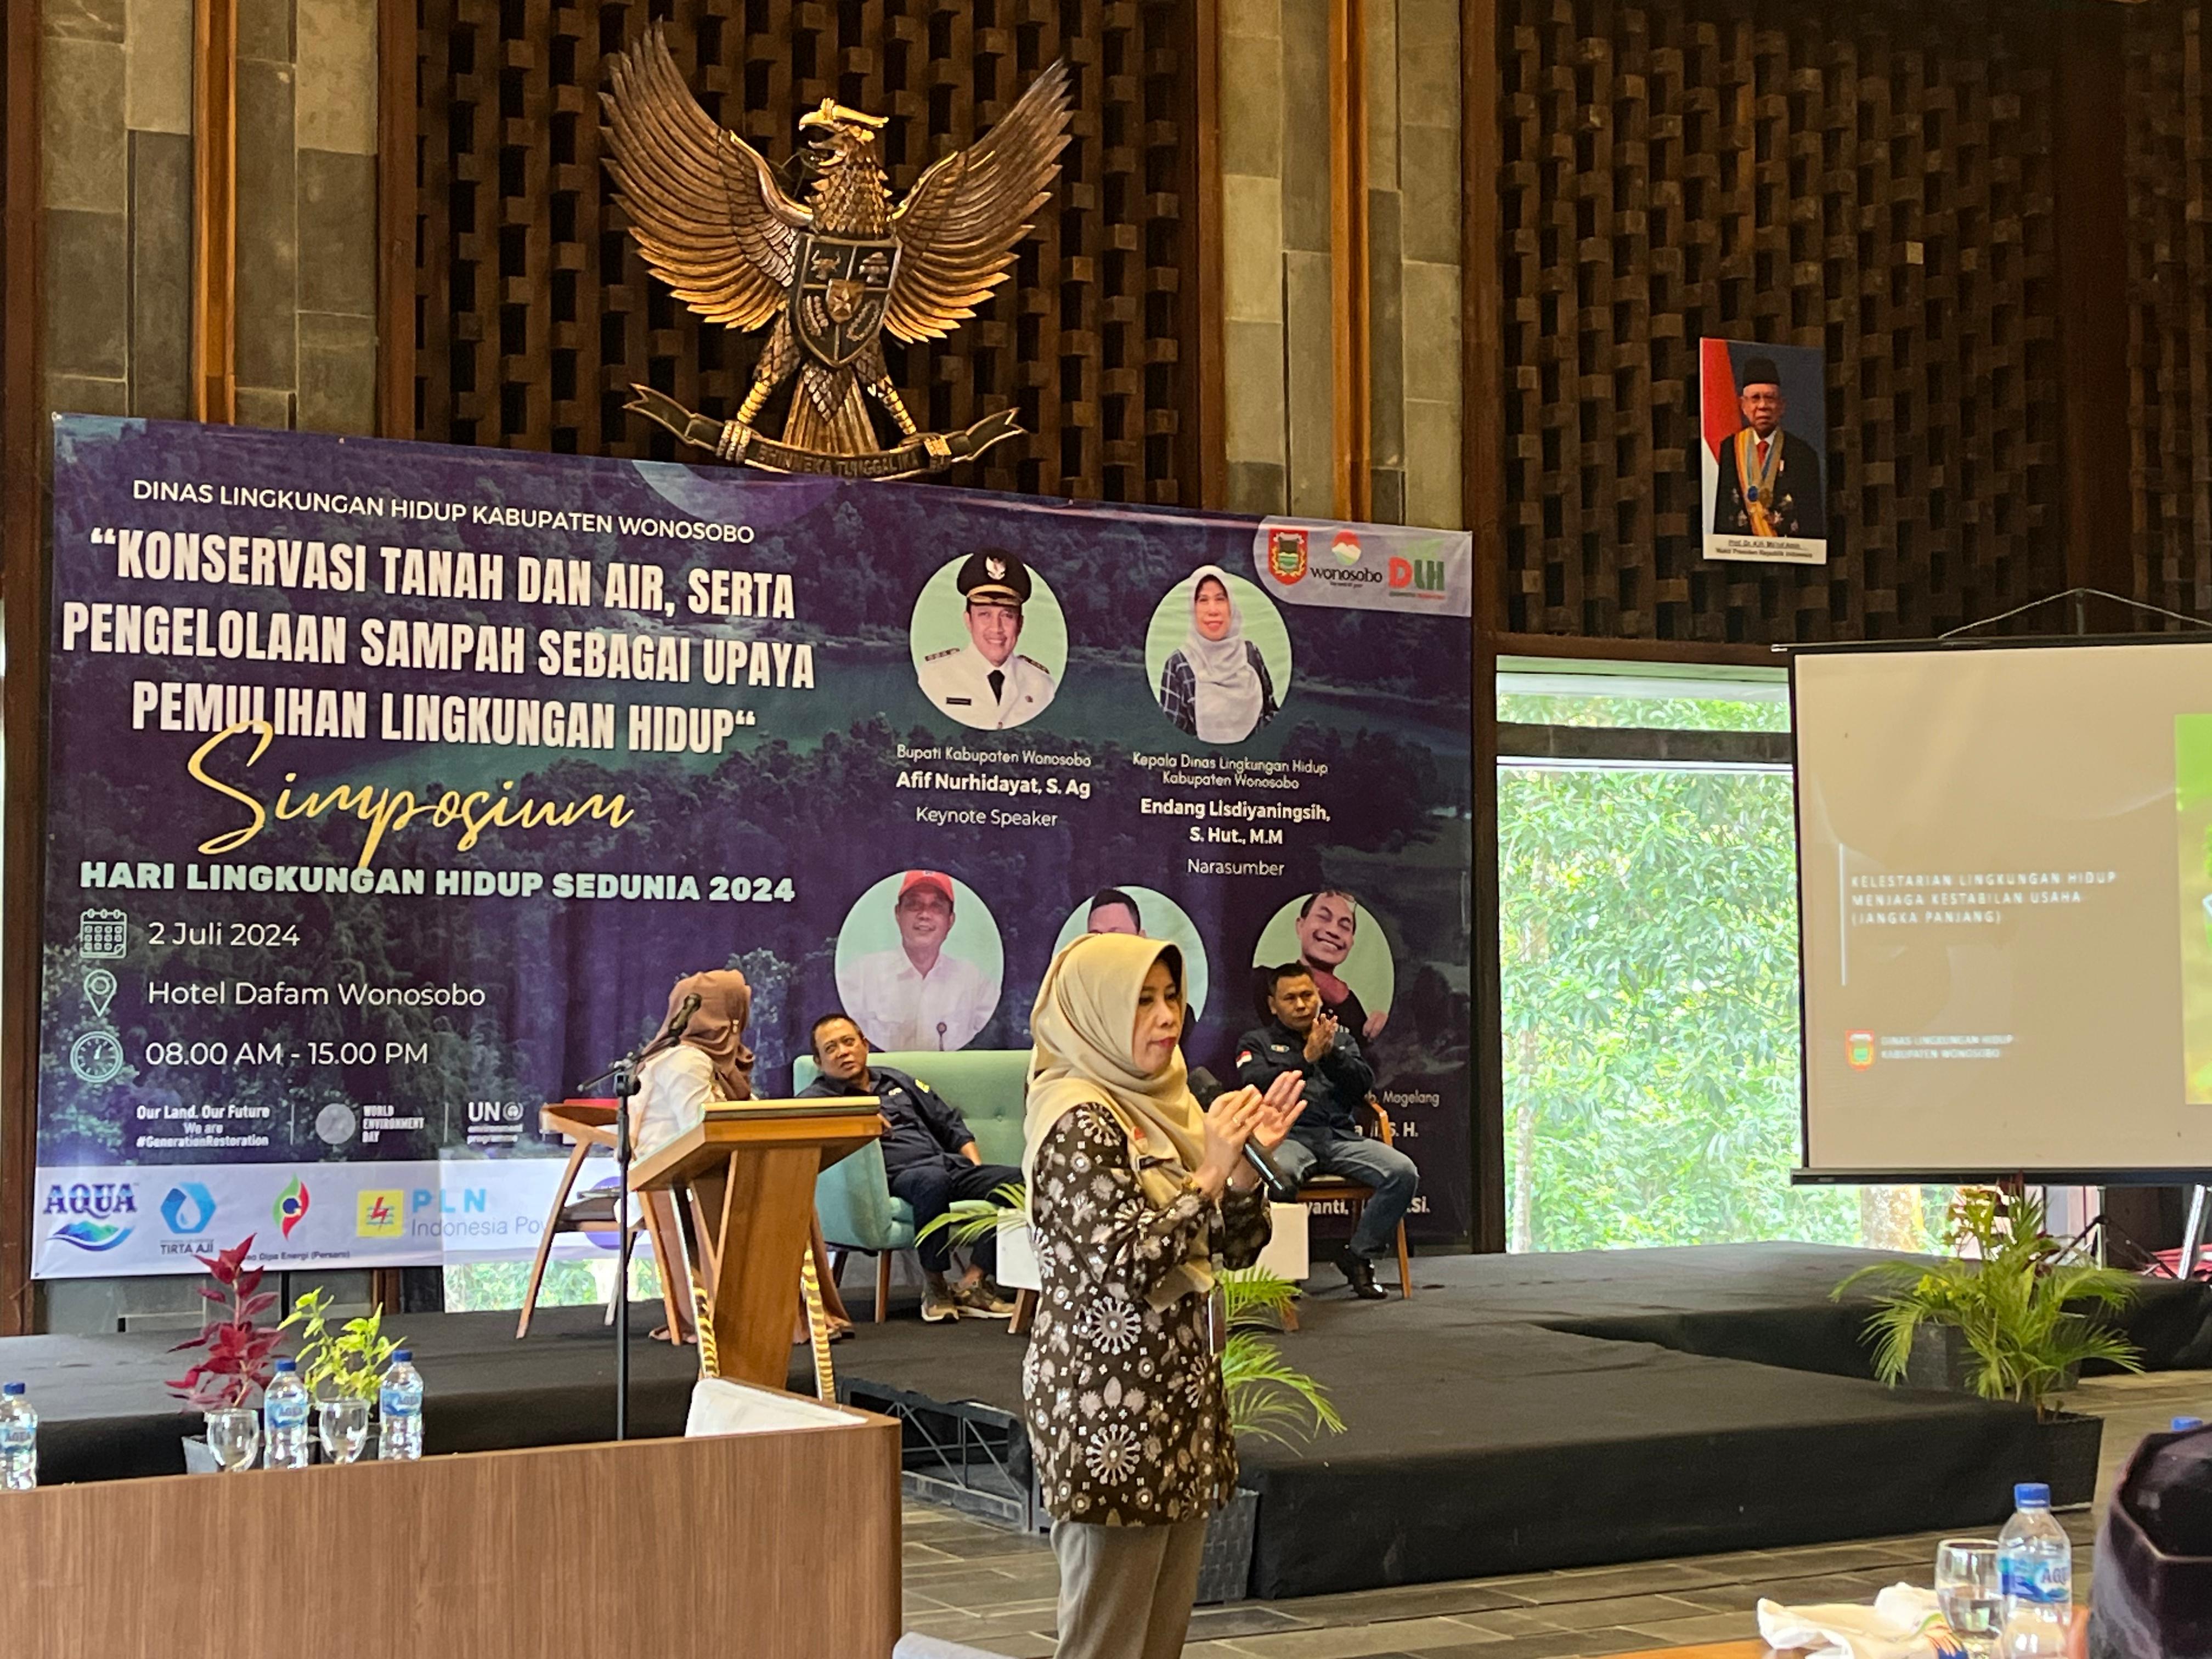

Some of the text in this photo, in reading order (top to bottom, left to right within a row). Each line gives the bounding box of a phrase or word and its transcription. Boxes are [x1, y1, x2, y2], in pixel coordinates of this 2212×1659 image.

[133, 479, 755, 544] DINAS LINGKUNGAN HIDUP KABUPATEN WONOSOBO
[89, 527, 795, 619] “KONSERVASI TANAH DAN AIR, SERTA
[62, 602, 815, 689] PENGELOLAAN SAMPAH SEBAGAI UPAYA
[132, 680, 367, 740] PEMULIHAN
[381, 692, 615, 750] LINGKUNGAN
[896, 743, 1092, 768] Bupati Kabupaten Wonosobo
[1132, 752, 1329, 777] Kepala Dinas Lingkungan Hidup
[895, 770, 1091, 800] Afif Nurhidayat, S. Ag
[1163, 771, 1300, 789] Kabupaten Wonosobo
[187, 719, 635, 870] Simposium
[916, 806, 1058, 828] Keynote Speaker
[1140, 798, 1331, 823] Endang Lisdiyaningsih,
[1189, 826, 1284, 845] S. Hut., M.M
[1187, 858, 1285, 877] Narasumber
[80, 860, 796, 902] HARI LINGKUNGAN HIDUP SEDUNIA 2024
[1851, 871, 2117, 888] KELESTARIAN LINGKUNGAN HIDUP
[1851, 890, 2082, 907] MENJAGA KESTABILAN USAHA
[1925, 910, 2001, 924] PANJANG)
[148, 922, 300, 947] 2 Juli 2024
[148, 981, 486, 1007] Hotel Dafam Wonosobo
[145, 1042, 228, 1065] 08.00
[234, 1042, 281, 1065] AM
[308, 1042, 377, 1065] 15.00
[385, 1042, 428, 1065] PM
[1383, 1088, 1440, 1108] Magelang
[136, 1104, 270, 1121] Our Land. Our Future
[363, 1105, 395, 1117] WORLD
[467, 1101, 500, 1122] UN
[183, 1122, 224, 1135] We are
[362, 1116, 426, 1130] ENVIRONMENT
[1403, 1121, 1419, 1138] H.
[136, 1135, 269, 1148] #GenerationRestoration
[362, 1131, 381, 1143] DAY
[43, 1183, 138, 1220] AQUA
[411, 1188, 487, 1214] PLN
[411, 1217, 508, 1238] Indonesia
[160, 1243, 213, 1255] TIRTA AJI
